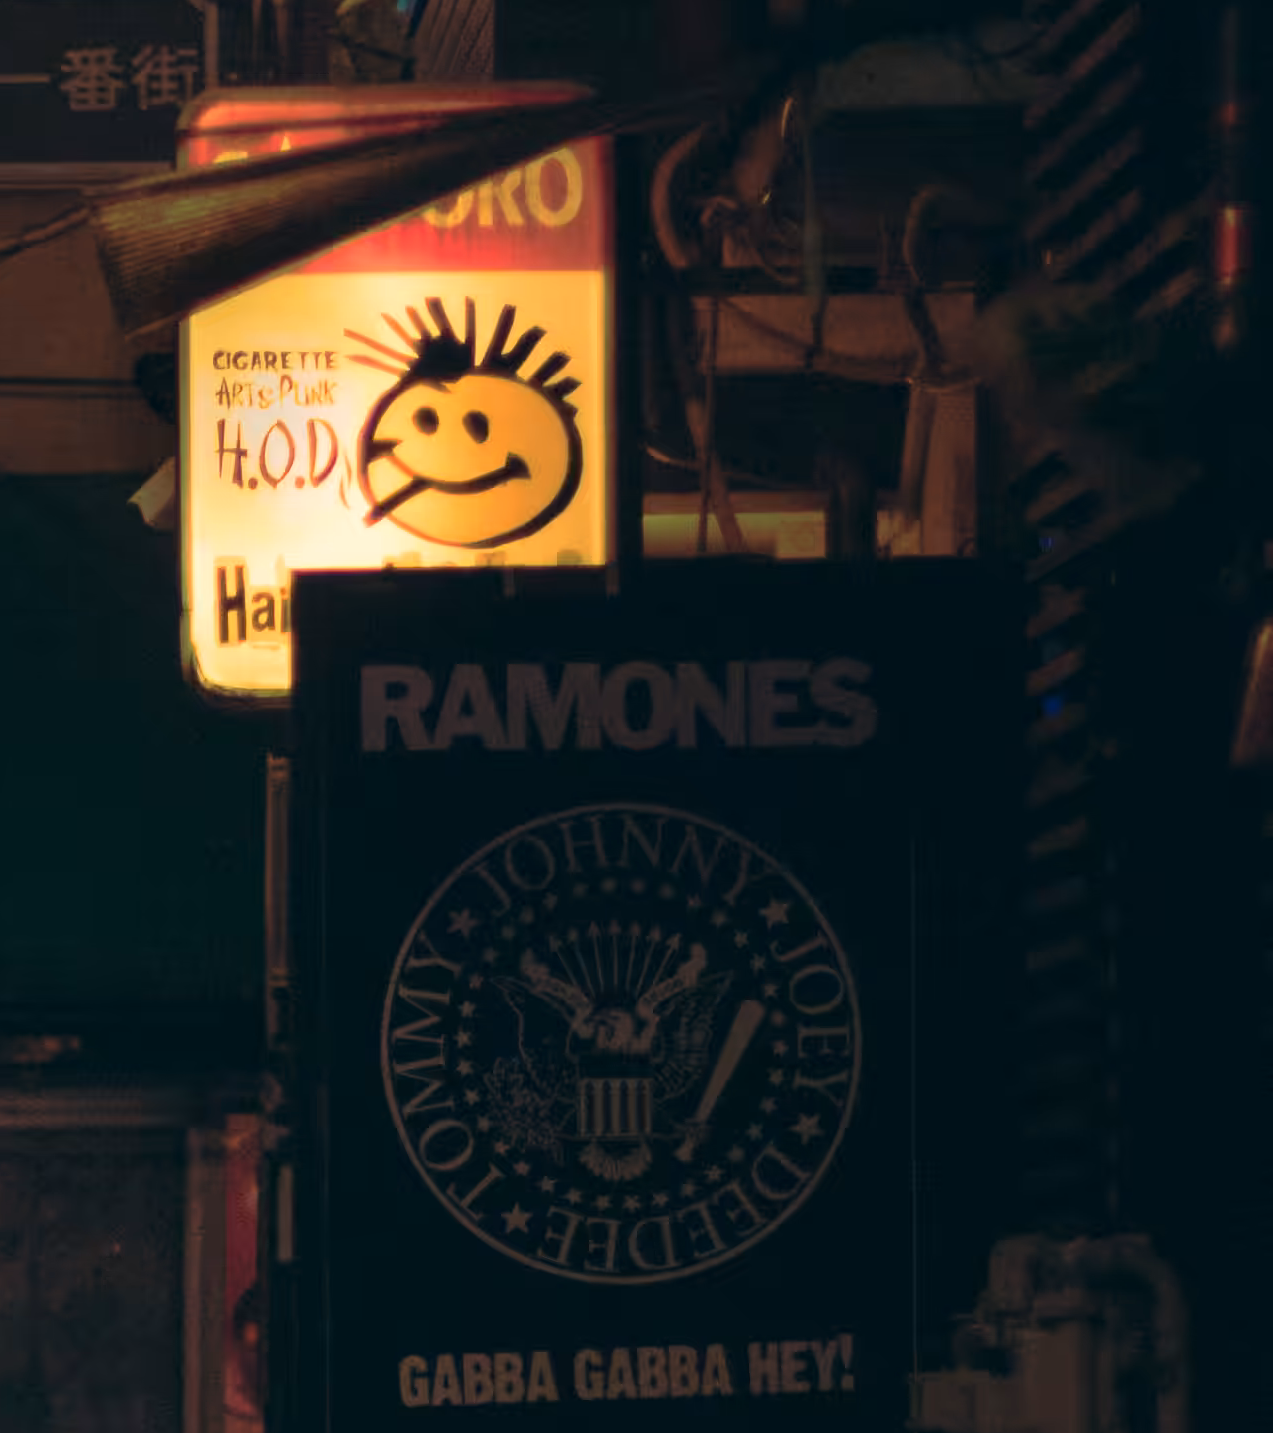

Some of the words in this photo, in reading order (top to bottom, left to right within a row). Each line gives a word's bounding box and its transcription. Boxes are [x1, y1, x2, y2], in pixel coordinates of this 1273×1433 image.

[212, 349, 338, 372] CIGARETTE
[359, 658, 879, 754] RAMONES
[472, 814, 777, 918] JOHNNY
[769, 930, 852, 1111] JOEY
[391, 929, 510, 1225] TOMMY
[397, 1348, 560, 1409] GABBA
[573, 1340, 735, 1402] GABBA
[747, 1331, 855, 1397] HEY!
